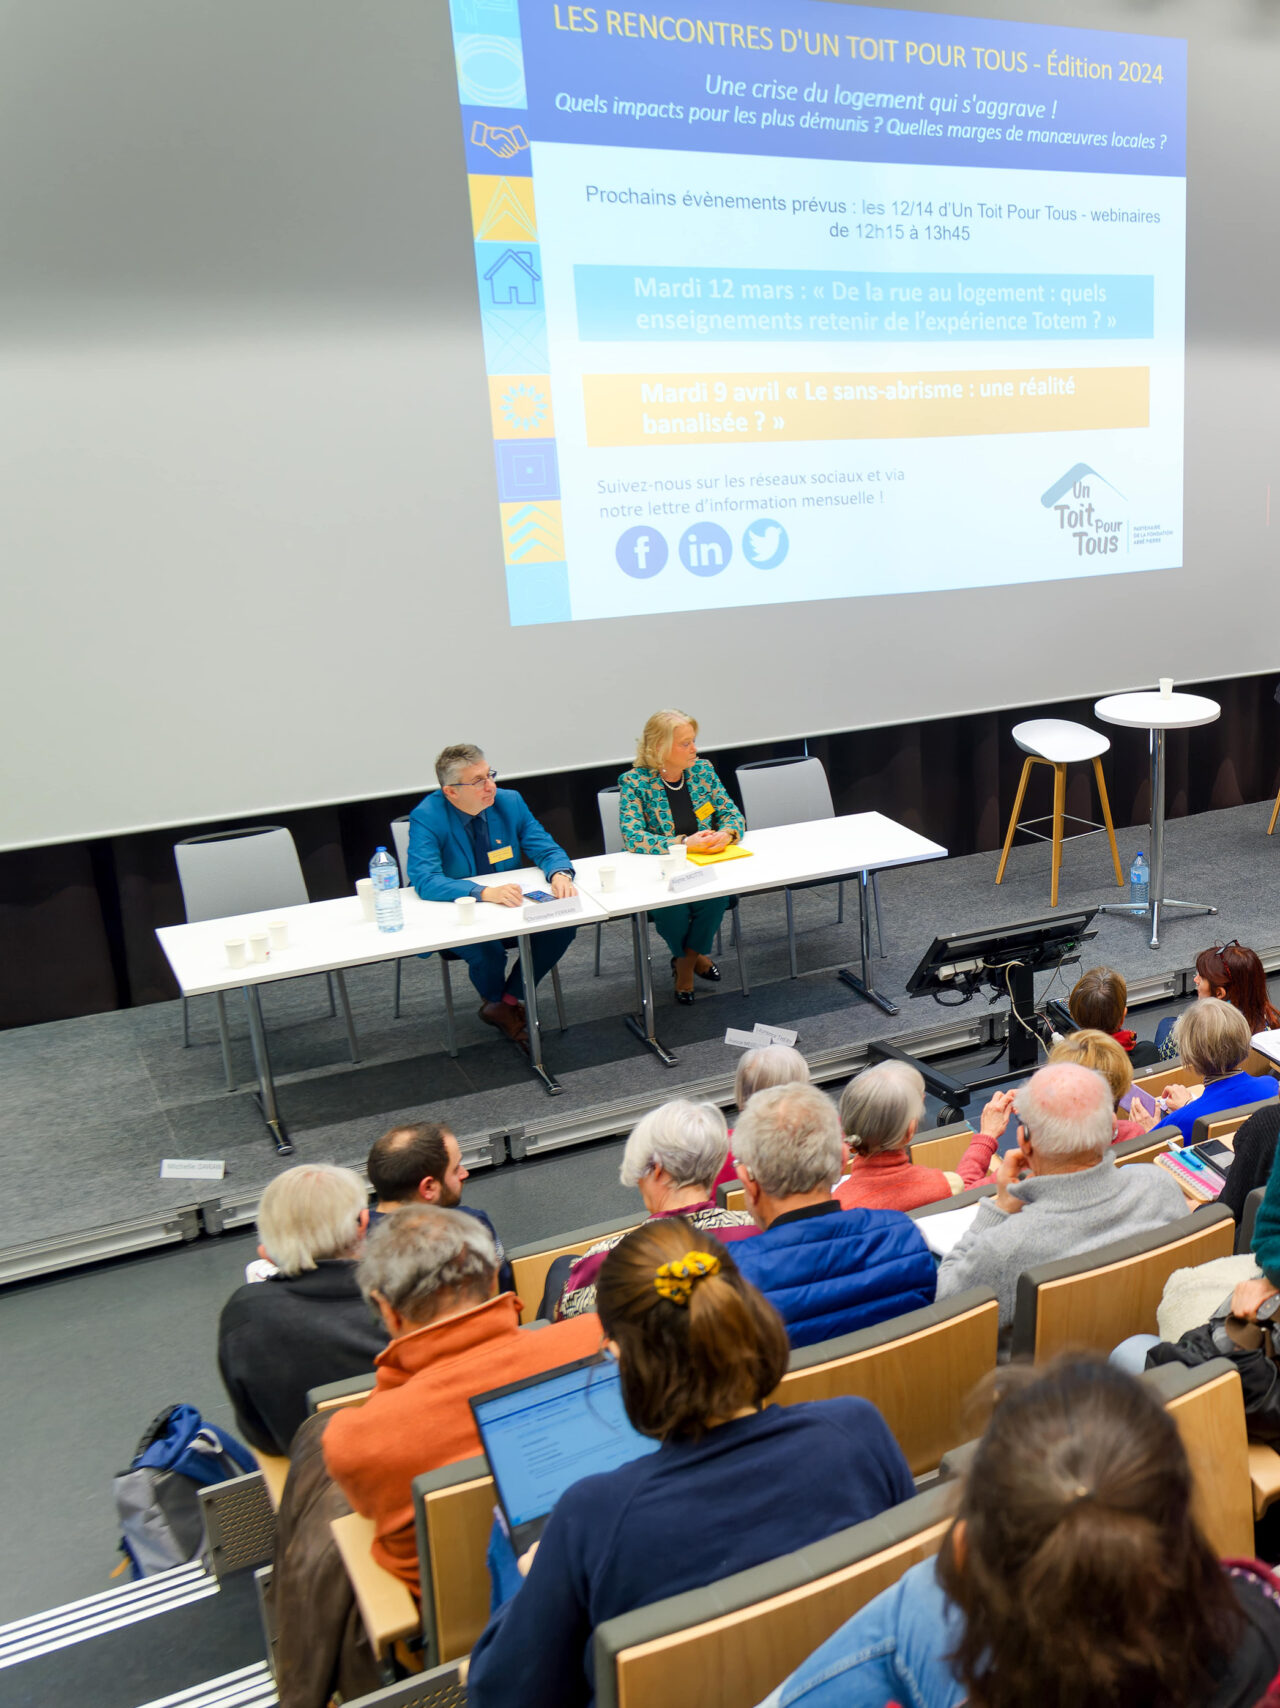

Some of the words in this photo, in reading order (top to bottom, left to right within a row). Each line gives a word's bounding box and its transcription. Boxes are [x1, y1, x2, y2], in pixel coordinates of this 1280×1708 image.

[553, 4, 599, 33] LES
[606, 9, 773, 50] RENCONTRES
[780, 28, 840, 57] D'UN
[845, 35, 899, 62] TOIT
[905, 41, 967, 69] POUR
[971, 47, 1028, 73] TOUS
[1047, 48, 1113, 80] Édition
[1118, 61, 1164, 85] 2024
[705, 73, 747, 97] Une
[752, 79, 798, 101] crise
[803, 81, 829, 103] du
[834, 83, 925, 111] logement
[929, 94, 958, 115] qui
[961, 94, 1046, 120] s'aggrave
[555, 92, 608, 114] Quels
[612, 96, 684, 120] impacts
[689, 105, 730, 124] pour
[733, 105, 757, 125] les
[761, 108, 795, 129] plus
[799, 111, 869, 133] démunis
[886, 117, 943, 137] Quelles
[947, 124, 1002, 143] marges
[1005, 125, 1023, 142] de
[1026, 128, 1108, 146] manœuvres
[1111, 131, 1156, 149] locales
[585, 185, 677, 207] Prochains
[682, 191, 787, 211] évènements
[792, 197, 847, 215] prévus
[862, 199, 886, 216] les
[891, 200, 934, 217] 12/14
[938, 201, 973, 218] d'Un
[977, 202, 1003, 219] Toit
[1007, 204, 1041, 220] Pour
[1044, 205, 1077, 222] Tous
[1090, 207, 1161, 224] webinaires
[829, 221, 849, 238] de
[855, 222, 904, 240] 12h15
[909, 224, 919, 240] à
[924, 225, 970, 241] 13h45
[634, 276, 701, 299] Mardi
[709, 278, 735, 299] 12
[741, 283, 794, 300] mars
[833, 281, 860, 301] De
[865, 281, 883, 302] la
[889, 286, 923, 302] rue
[928, 286, 951, 302] au
[957, 282, 1044, 306] logement
[1060, 283, 1107, 306] quels
[636, 310, 803, 334] enseignements
[809, 311, 878, 331] retenir
[884, 311, 910, 331] de
[915, 310, 1028, 334] l'expérience
[1032, 310, 1087, 330] Totem
[641, 381, 708, 403] Mardi
[713, 382, 727, 402] 9
[733, 380, 779, 401] avril
[805, 381, 828, 401] Le
[833, 380, 964, 401] sans-abrisme
[980, 380, 1014, 397] une
[1019, 375, 1076, 396] réalité
[643, 410, 749, 434] banalisée
[597, 477, 692, 494] Suivez-nous
[697, 477, 720, 490] sur
[725, 474, 745, 488] les
[750, 472, 807, 487] réseaux
[811, 470, 863, 486] sociaux
[867, 469, 881, 482] et
[885, 467, 905, 482] via
[1072, 480, 1090, 499] Un
[600, 502, 643, 518] notre
[648, 499, 690, 516] lettre
[695, 496, 797, 513] d'information
[802, 491, 875, 508] mensuelle
[1054, 502, 1095, 529] Toit
[1095, 518, 1123, 533] Pour
[1072, 531, 1119, 556] Tous
